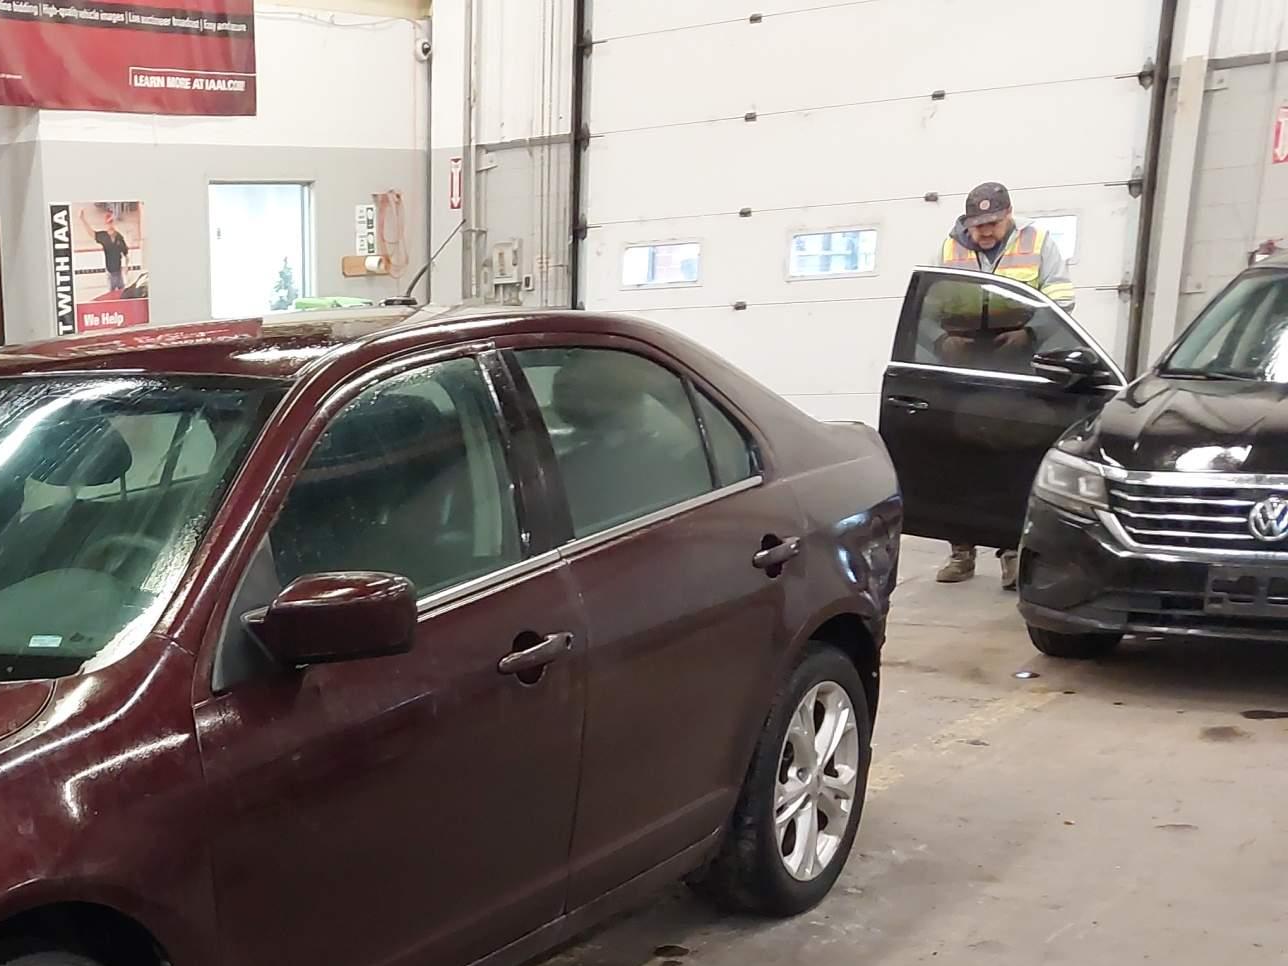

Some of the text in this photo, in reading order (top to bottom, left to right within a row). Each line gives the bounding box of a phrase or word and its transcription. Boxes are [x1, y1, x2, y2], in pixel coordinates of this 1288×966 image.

[133, 75, 165, 88] LEARN
[166, 76, 192, 90] MORE
[192, 79, 205, 90] AT
[52, 209, 70, 249] IAA
[55, 256, 73, 317] WITH
[83, 311, 124, 327] We Help
